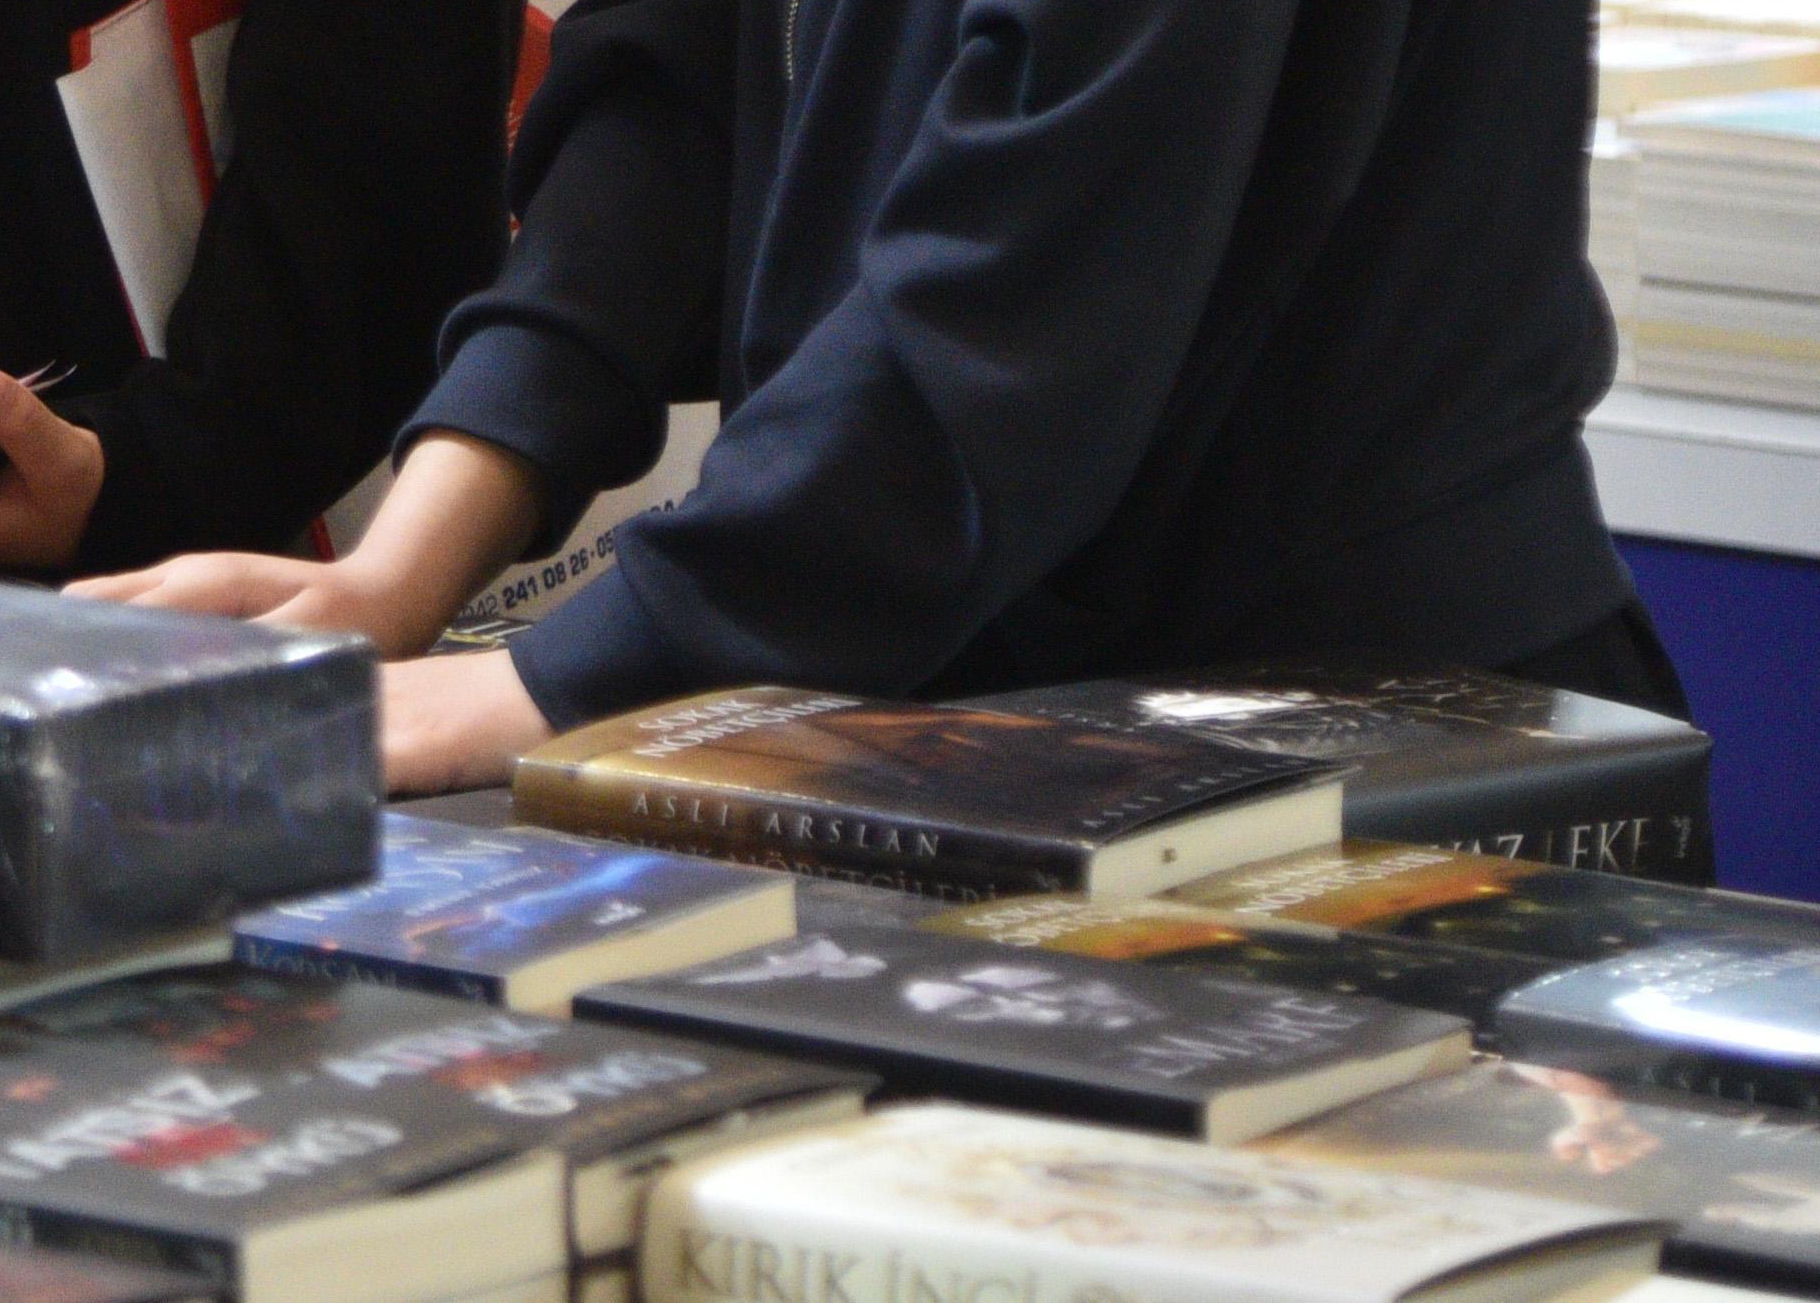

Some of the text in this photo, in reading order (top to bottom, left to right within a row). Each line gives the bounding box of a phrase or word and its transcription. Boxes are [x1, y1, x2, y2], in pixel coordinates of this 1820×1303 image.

[503, 575, 539, 609] 241
[543, 561, 567, 590] 08
[570, 547, 591, 577] 26
[640, 696, 760, 734] SOKAK
[633, 790, 732, 828] ASLI
[765, 811, 940, 858] ARSLAN
[676, 1230, 851, 1303] KIRIK
